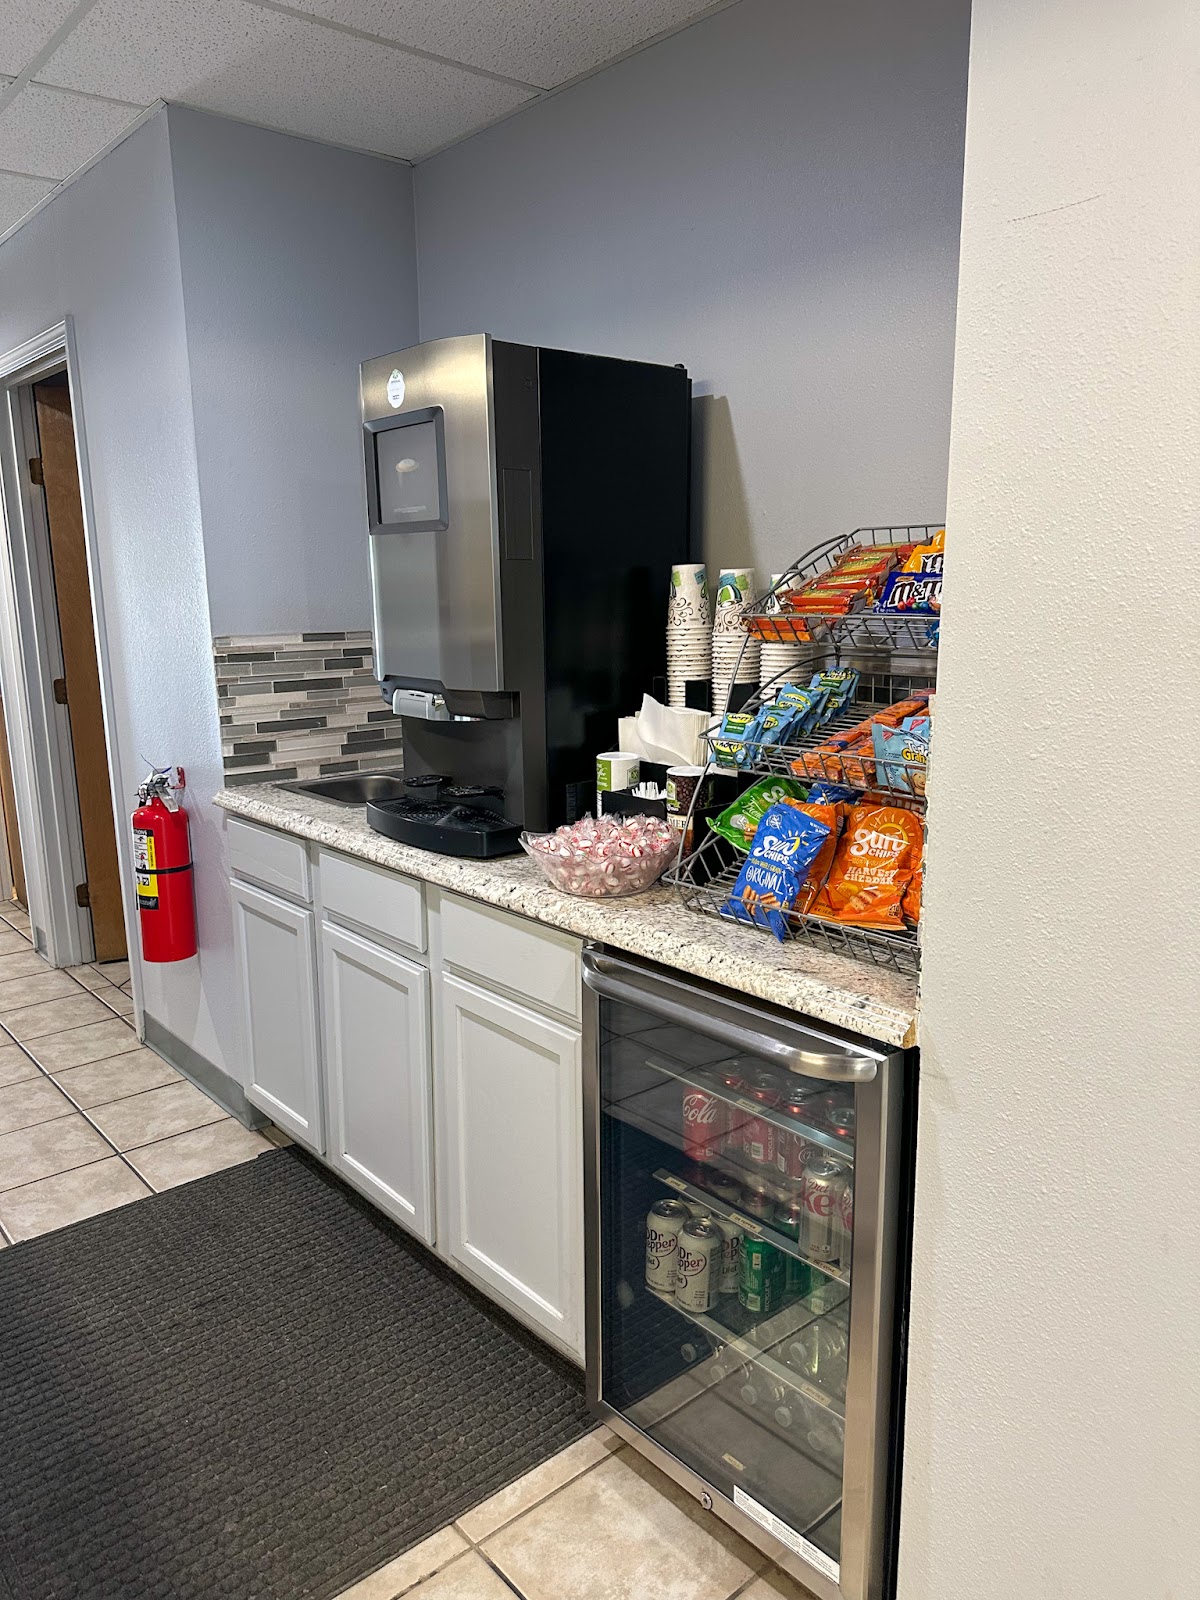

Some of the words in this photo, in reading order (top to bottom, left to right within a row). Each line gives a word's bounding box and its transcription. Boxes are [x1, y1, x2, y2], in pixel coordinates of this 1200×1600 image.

[753, 836, 798, 857] Sun
[850, 829, 906, 855] Sun
[764, 850, 789, 865] CHIPS
[868, 848, 900, 858] CHIPS
[846, 866, 897, 878] HARVEST
[746, 865, 784, 895] ORIGINAL
[844, 874, 894, 885] CHEDDAR
[683, 1094, 718, 1123] Cola
[808, 1178, 829, 1192] Diet
[650, 1230, 663, 1241] Dr
[680, 1246, 692, 1259] Dr
